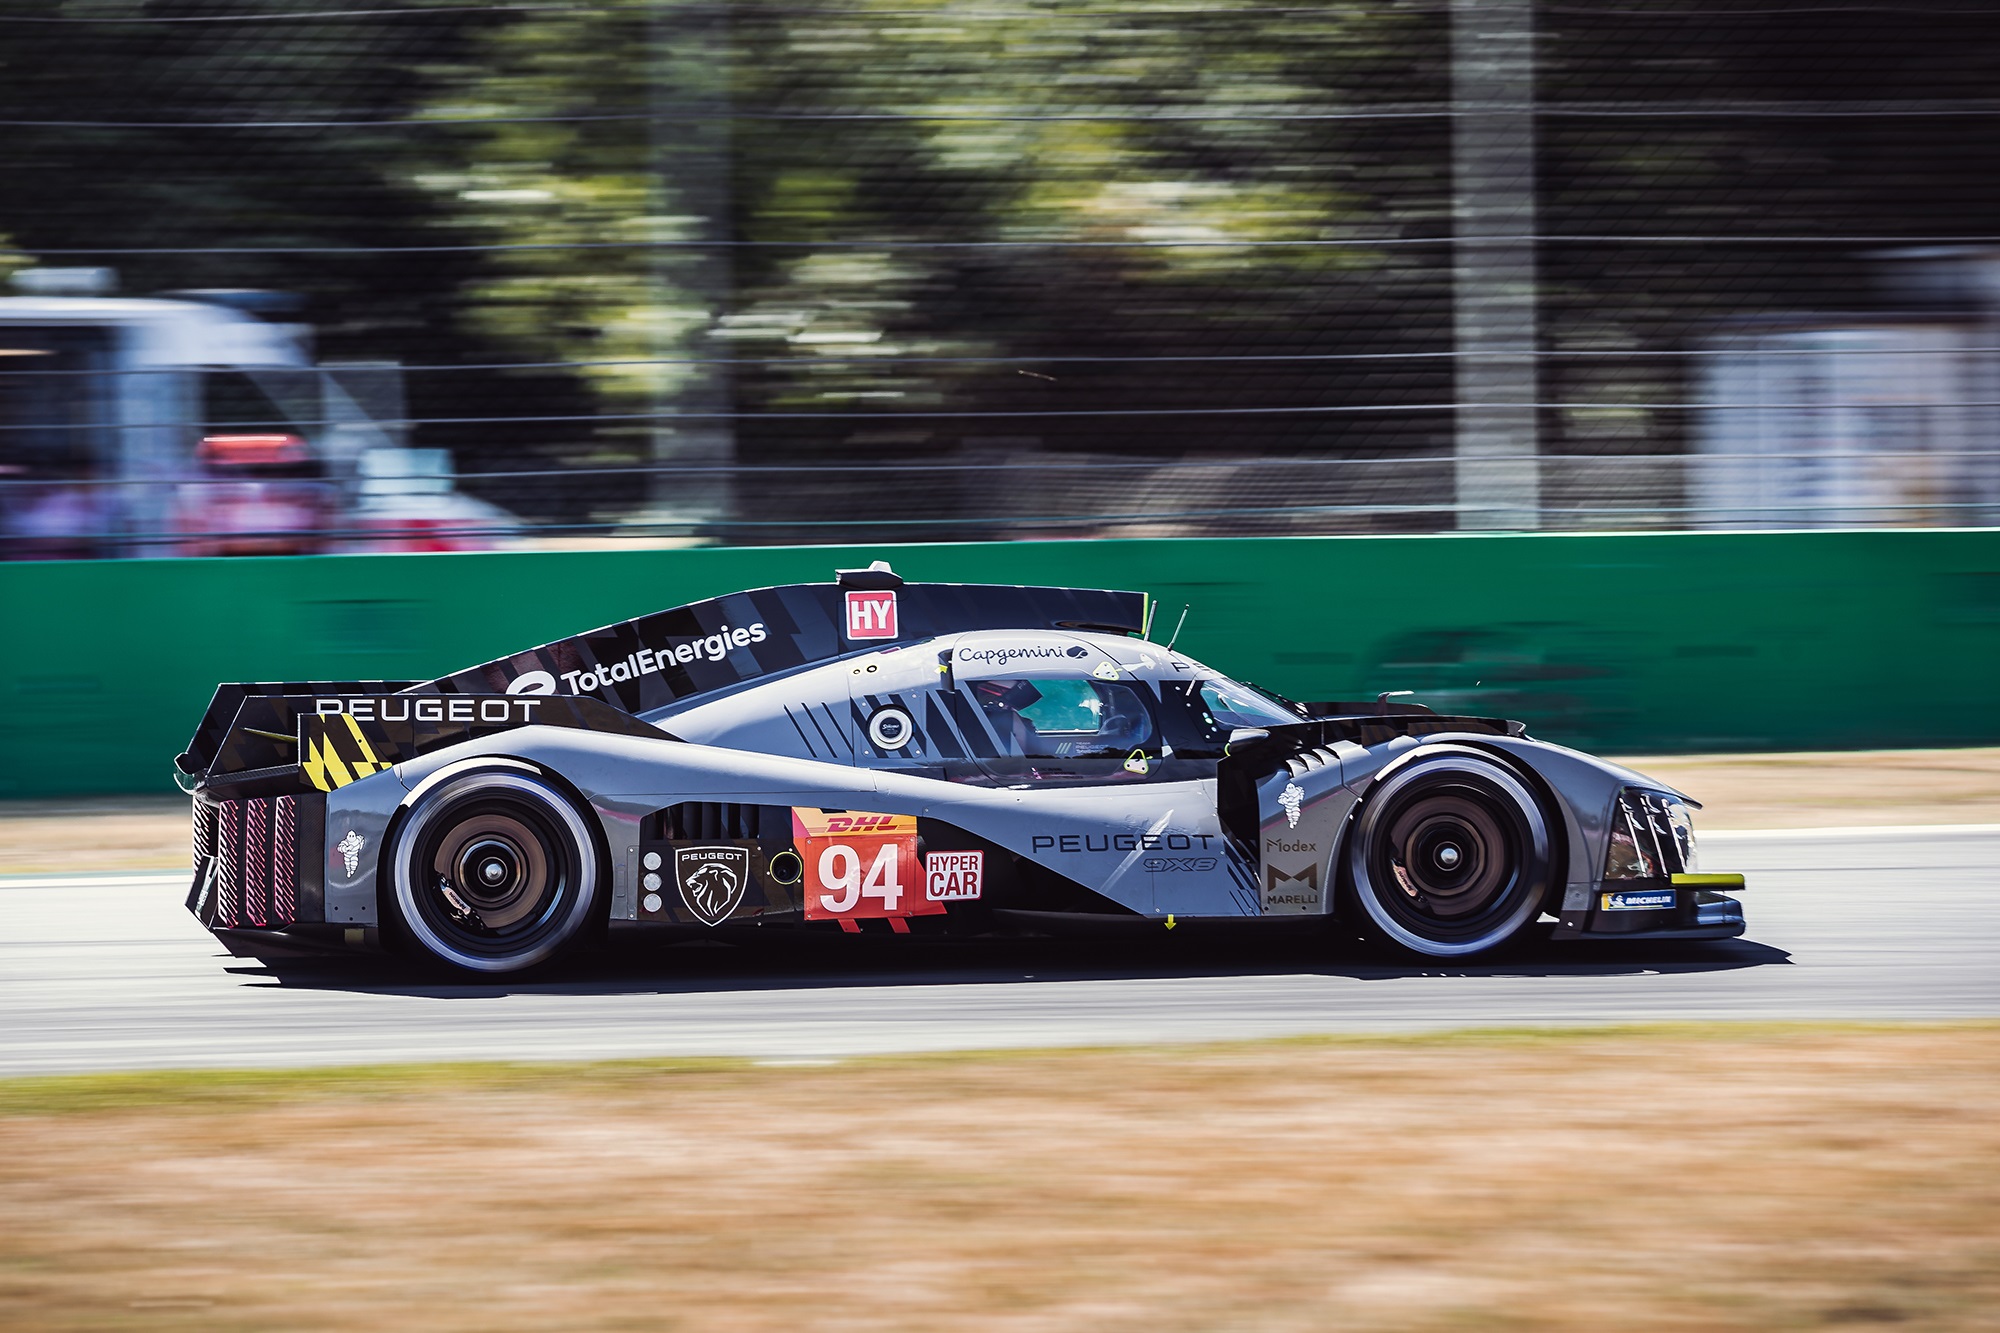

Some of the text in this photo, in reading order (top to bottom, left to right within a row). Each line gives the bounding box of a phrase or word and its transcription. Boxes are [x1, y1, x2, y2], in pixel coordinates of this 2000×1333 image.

[851, 600, 892, 629] HY
[560, 622, 767, 696] TotalEnergies
[960, 646, 1065, 665] Capgemini
[316, 699, 541, 722] PEUGEOT
[826, 816, 898, 832] DHL
[1032, 834, 1214, 853] PEUGEOT
[1266, 838, 1317, 852] Modex
[682, 853, 742, 861] PEUGEOT
[929, 855, 978, 871] HYPER
[1143, 857, 1218, 872] 9X8
[818, 843, 903, 912] 94
[929, 872, 977, 896] CAR
[1267, 895, 1318, 904] MARELLI
[1625, 896, 1672, 904] MICHELIN
